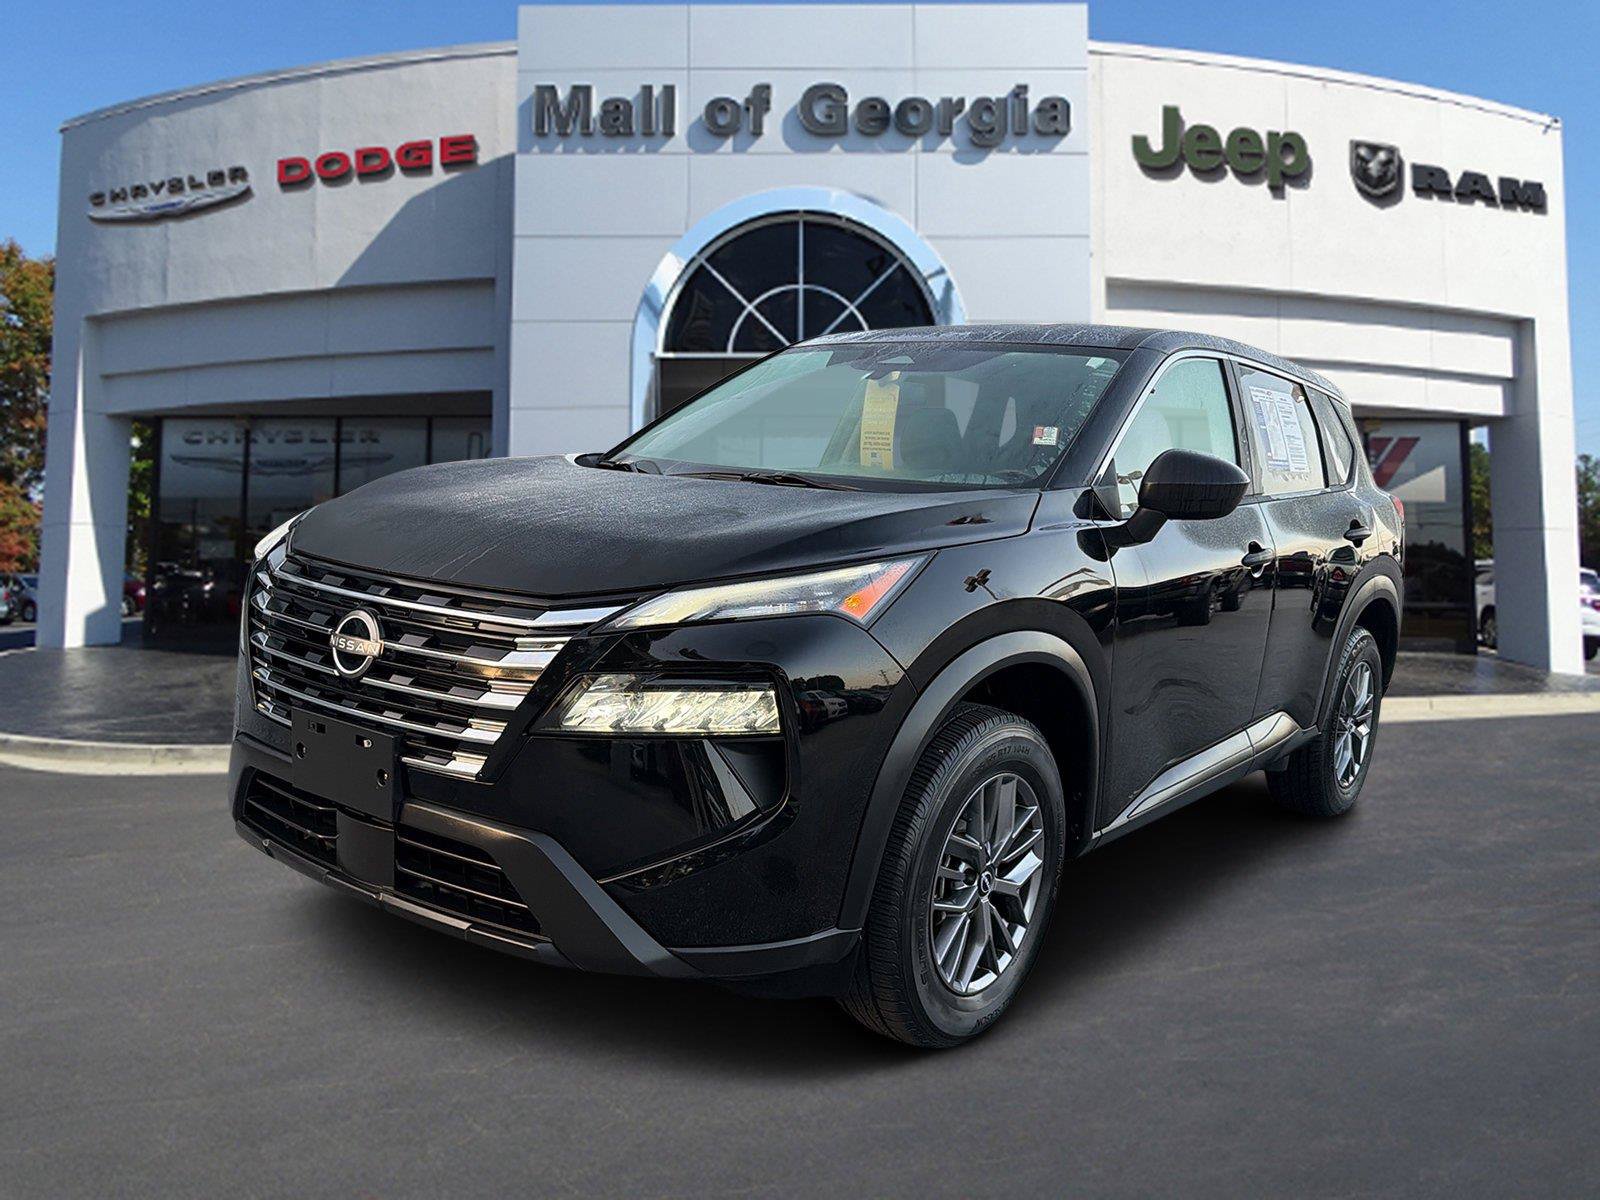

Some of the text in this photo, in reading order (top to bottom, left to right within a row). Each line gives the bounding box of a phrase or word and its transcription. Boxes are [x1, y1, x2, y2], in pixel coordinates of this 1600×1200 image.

[532, 83, 1072, 147] Mall of Georgia
[277, 134, 477, 186] DODGE
[1132, 105, 1309, 188] Jeep
[89, 165, 250, 207] CHRYSLER
[1411, 163, 1547, 213] RAM
[330, 634, 379, 656] NISSAN
